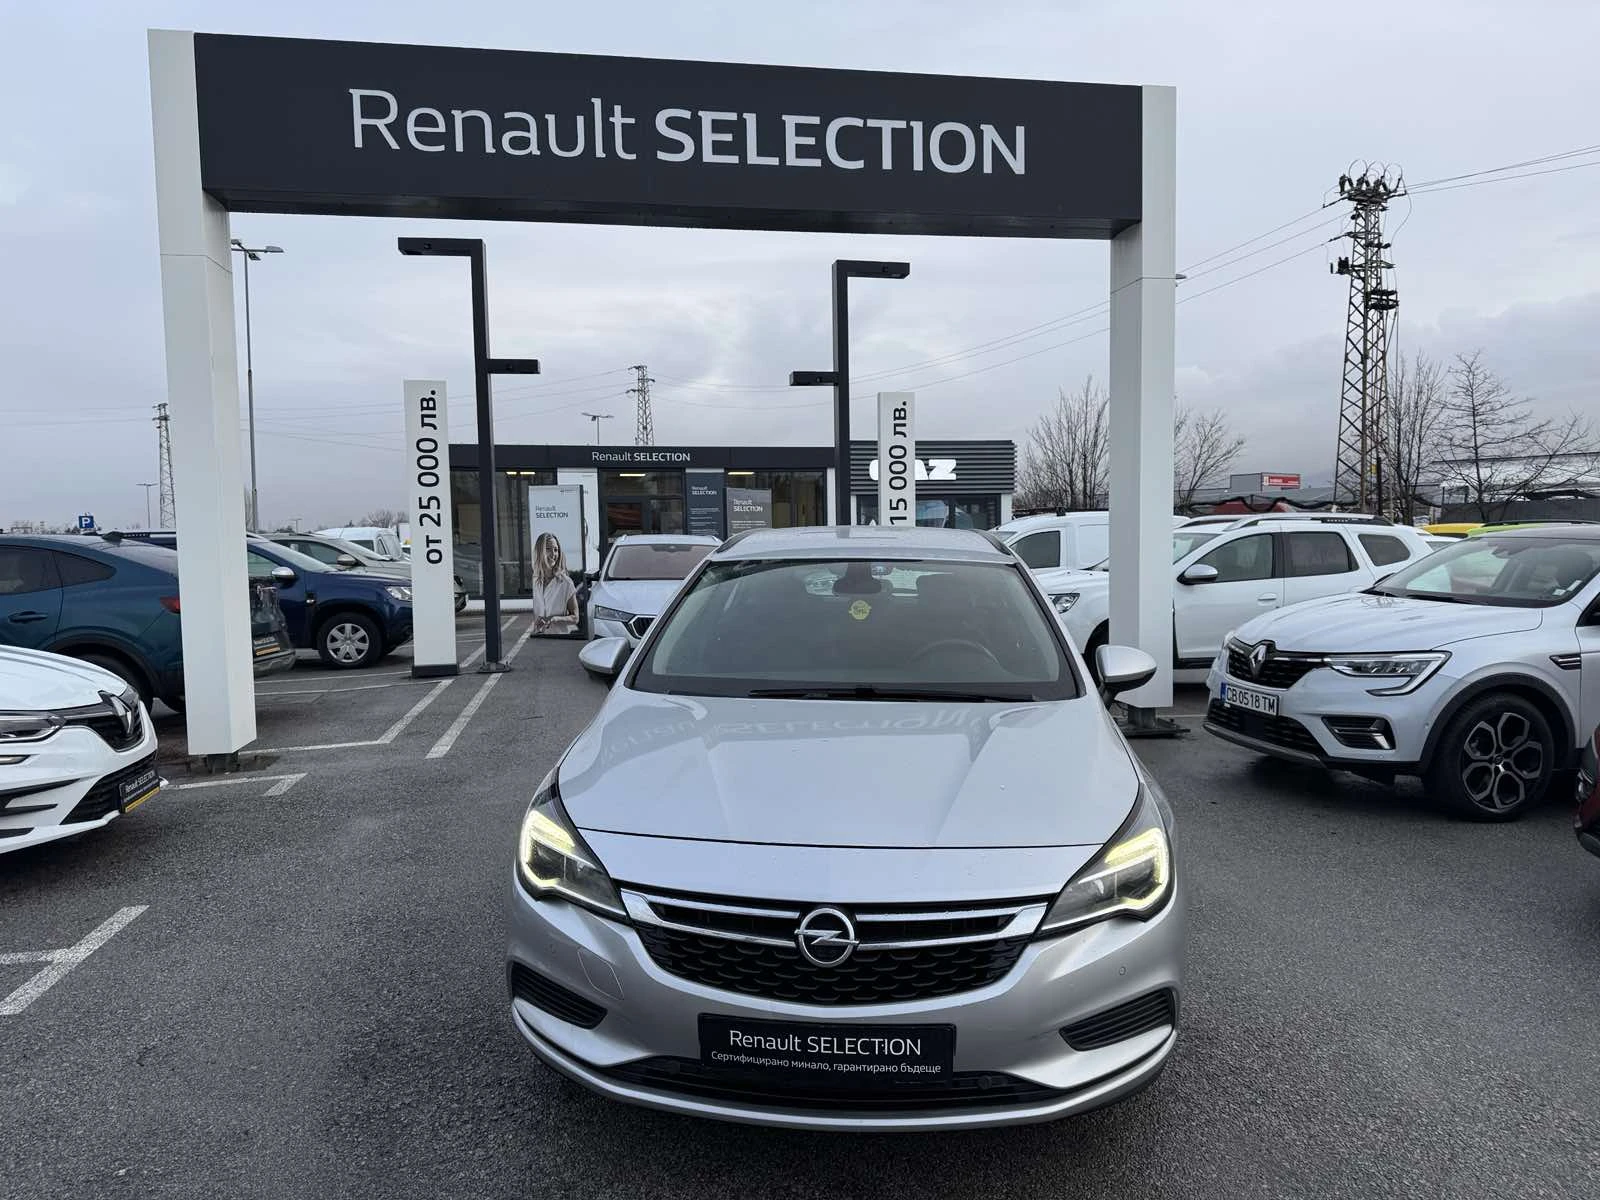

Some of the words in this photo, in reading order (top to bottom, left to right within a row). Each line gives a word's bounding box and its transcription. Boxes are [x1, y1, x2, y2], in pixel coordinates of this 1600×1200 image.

[348, 88, 637, 160] Renault
[655, 108, 1026, 175] SELECTION
[420, 390, 438, 430] лв.
[893, 401, 907, 438] лв.
[416, 437, 440, 488] 000
[592, 451, 632, 461] Renault
[634, 452, 690, 461] SELECTION
[889, 445, 907, 490] 000
[82, 517, 91, 528] P
[418, 496, 442, 527] 25
[889, 498, 907, 525] 15
[426, 535, 443, 564] от
[1226, 687, 1238, 702] CB
[1238, 691, 1260, 709] 0518
[1261, 696, 1275, 713] TM
[729, 1030, 802, 1052] Renault
[807, 1036, 921, 1056] SELECTION
[711, 1050, 790, 1068] Сертифицирано
[791, 1059, 832, 1071] минало,
[833, 1063, 899, 1075] гарантирано
[900, 1063, 941, 1074] бъдеще
